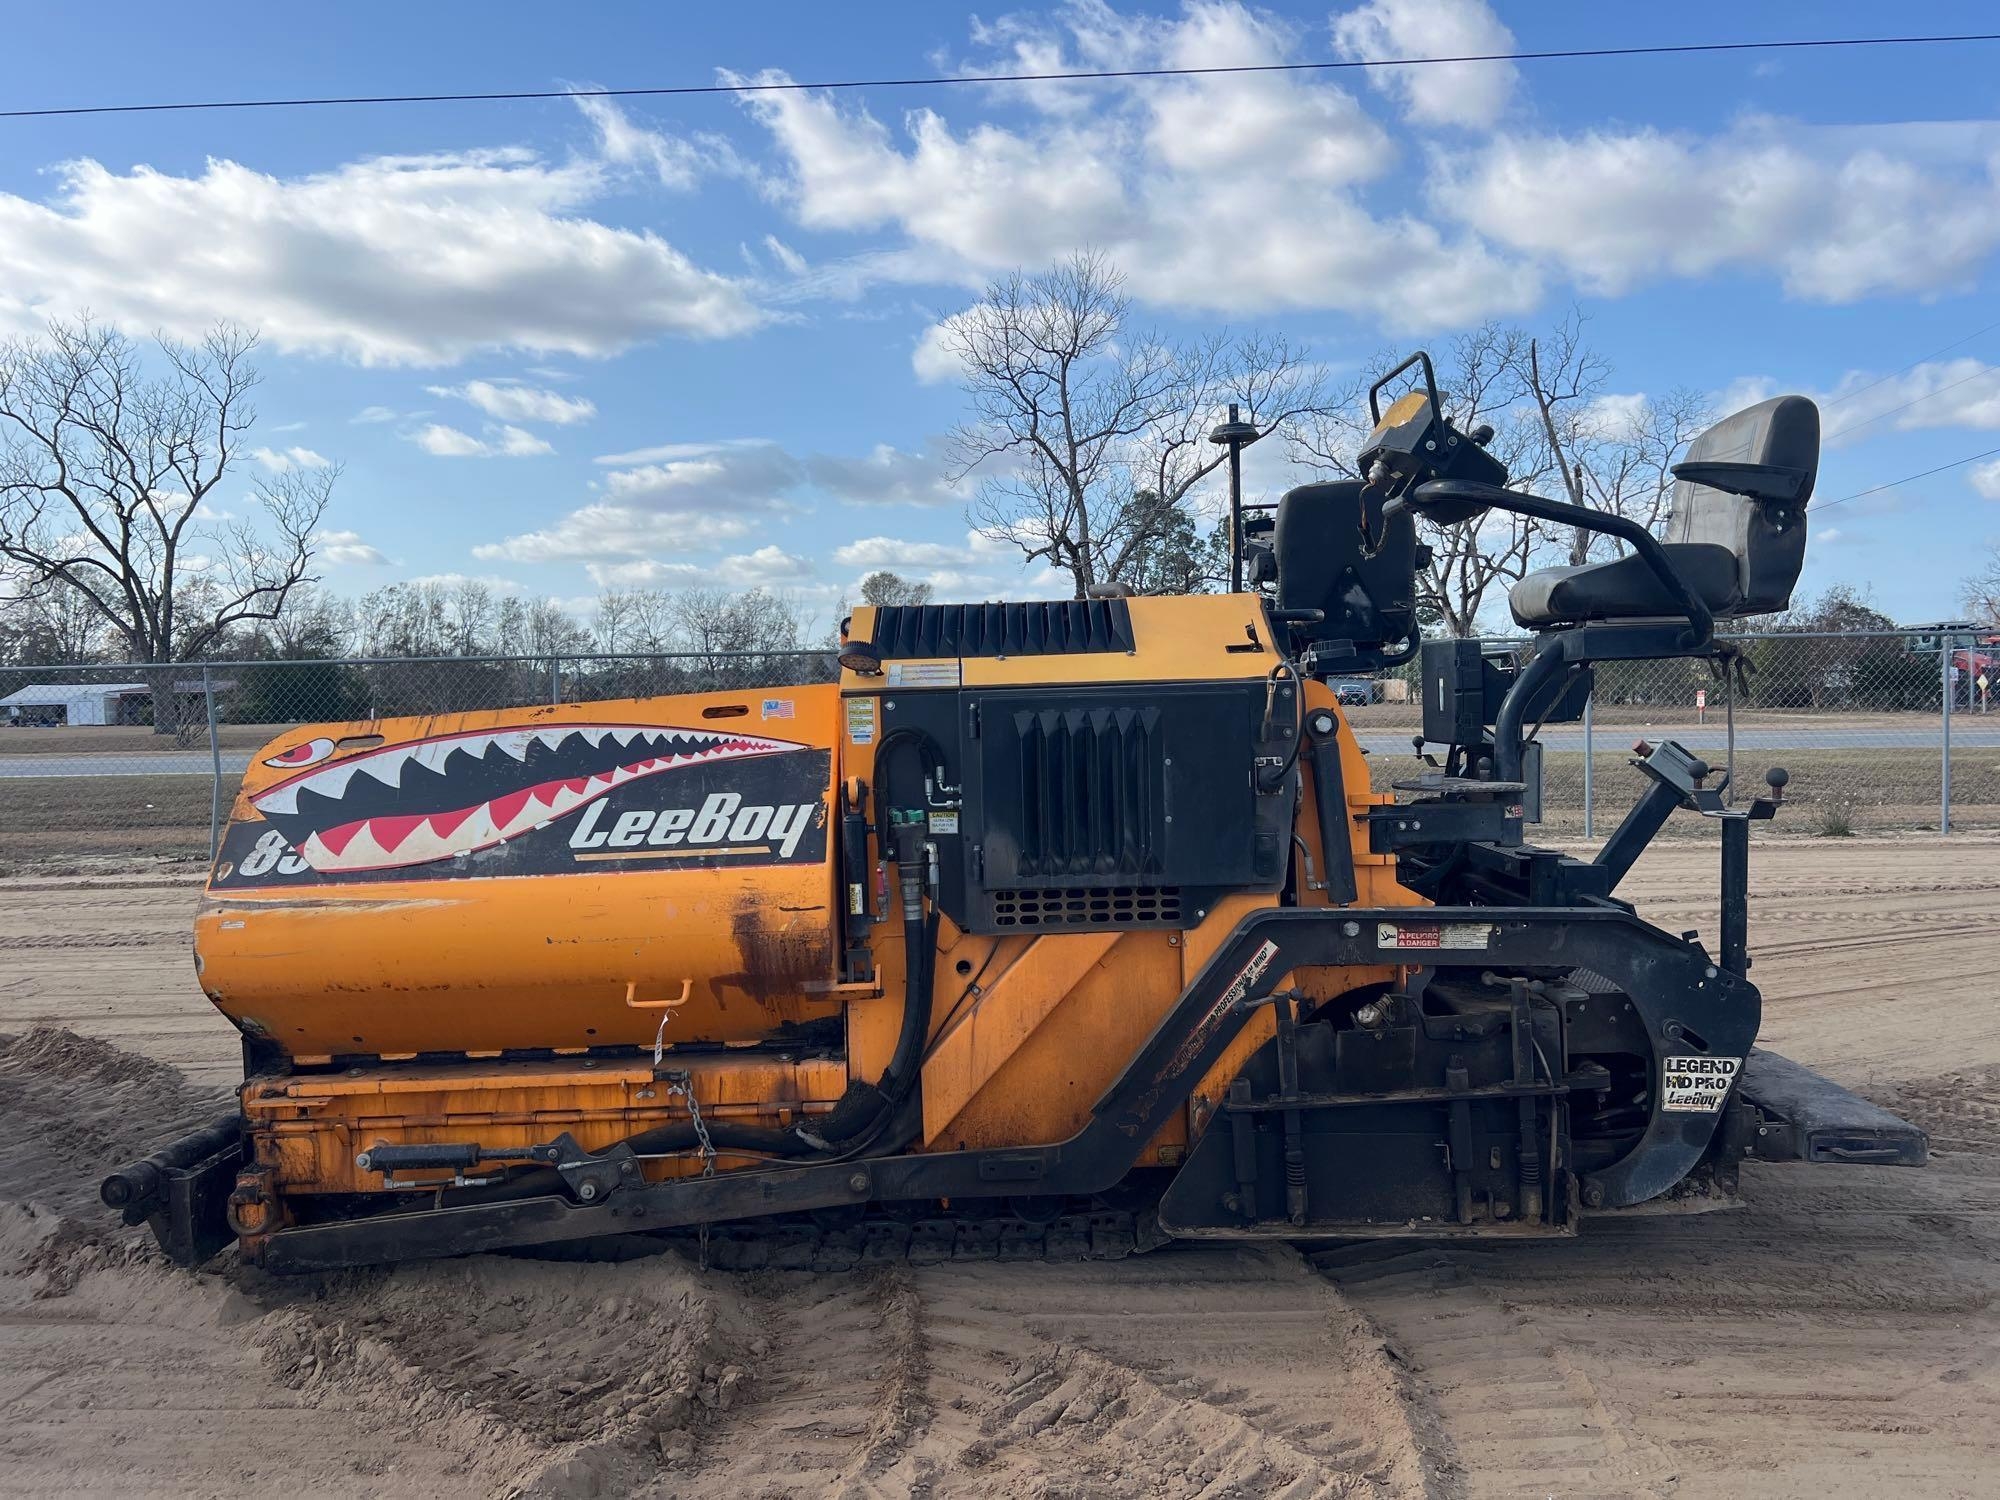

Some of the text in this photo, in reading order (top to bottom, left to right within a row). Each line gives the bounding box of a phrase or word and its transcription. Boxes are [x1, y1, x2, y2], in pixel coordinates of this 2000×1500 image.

[569, 792, 816, 859] LeeBoy
[1667, 1059, 1734, 1074] LEGEND
[1695, 1077, 1726, 1089] PRO
[1668, 1091, 1717, 1109] LeeBoy
